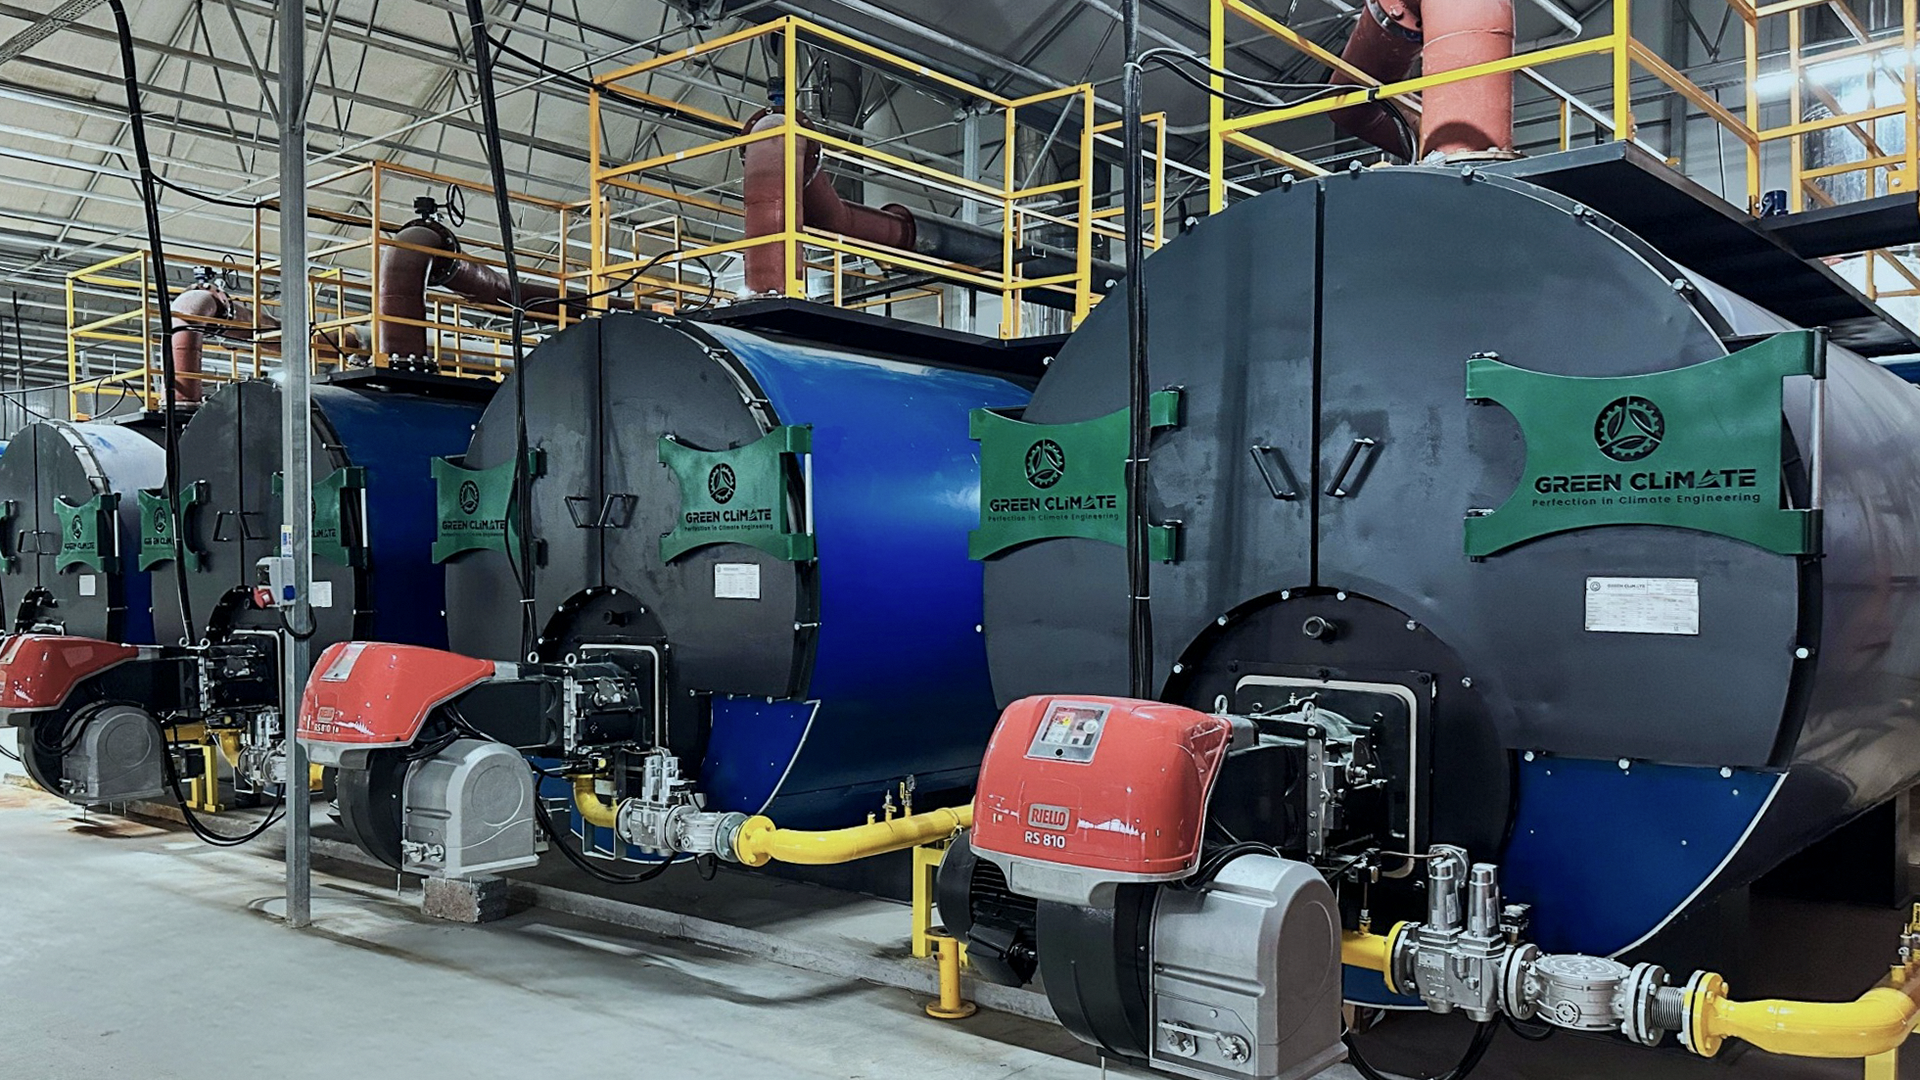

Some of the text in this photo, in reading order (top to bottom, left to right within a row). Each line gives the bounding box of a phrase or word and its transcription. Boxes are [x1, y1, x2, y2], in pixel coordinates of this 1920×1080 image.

[1534, 474, 1622, 494] GREEN
[989, 497, 1040, 512] GREEN
[1532, 493, 1760, 507] Perfection in Climate Engineering
[685, 511, 720, 523] GREEN
[988, 514, 1026, 522] Perfection
[1071, 513, 1119, 522] Engineering
[442, 520, 468, 530] GREEN
[1031, 808, 1067, 827] RIELLO
[1024, 830, 1067, 849] RS 810
